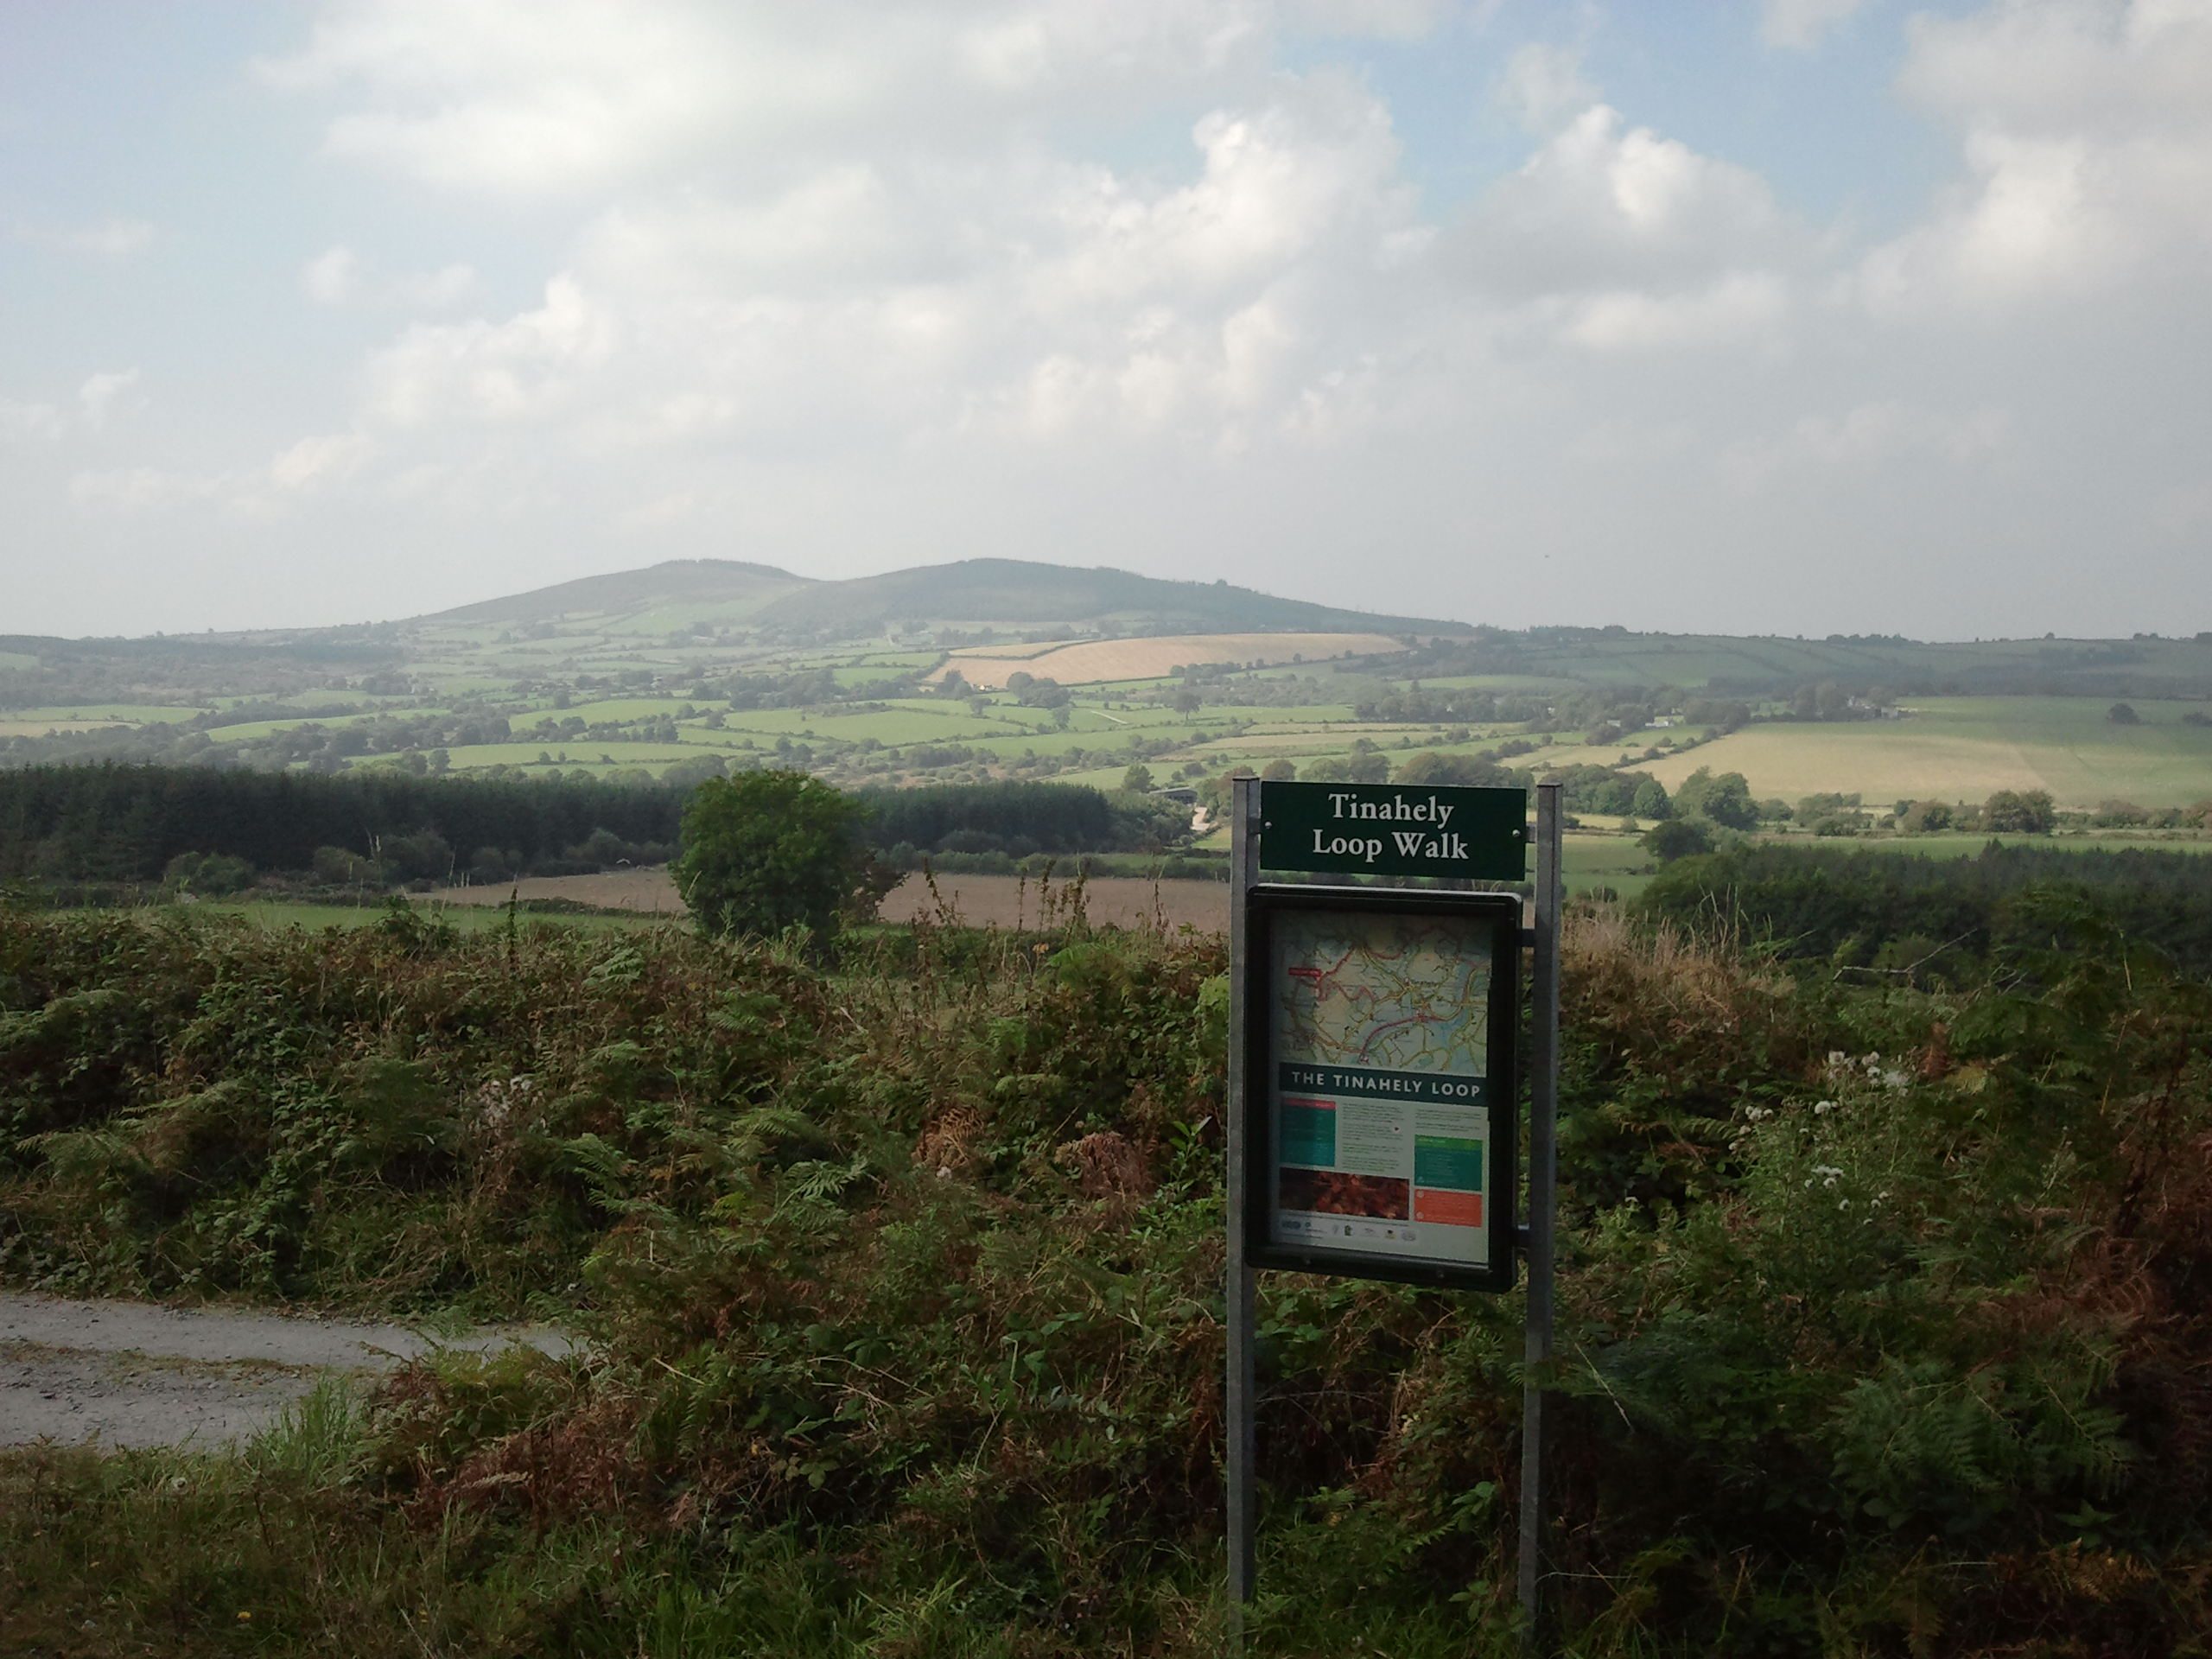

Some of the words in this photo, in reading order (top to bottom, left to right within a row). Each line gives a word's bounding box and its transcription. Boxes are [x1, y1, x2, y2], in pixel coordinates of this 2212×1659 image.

[1328, 793, 1454, 830] Tinahely
[1313, 829, 1382, 863] Loop
[1391, 831, 1469, 860] Walk
[1292, 1071, 1325, 1086] THE
[1333, 1074, 1422, 1093] TINAHELY
[1431, 1082, 1480, 1097] LOOP
